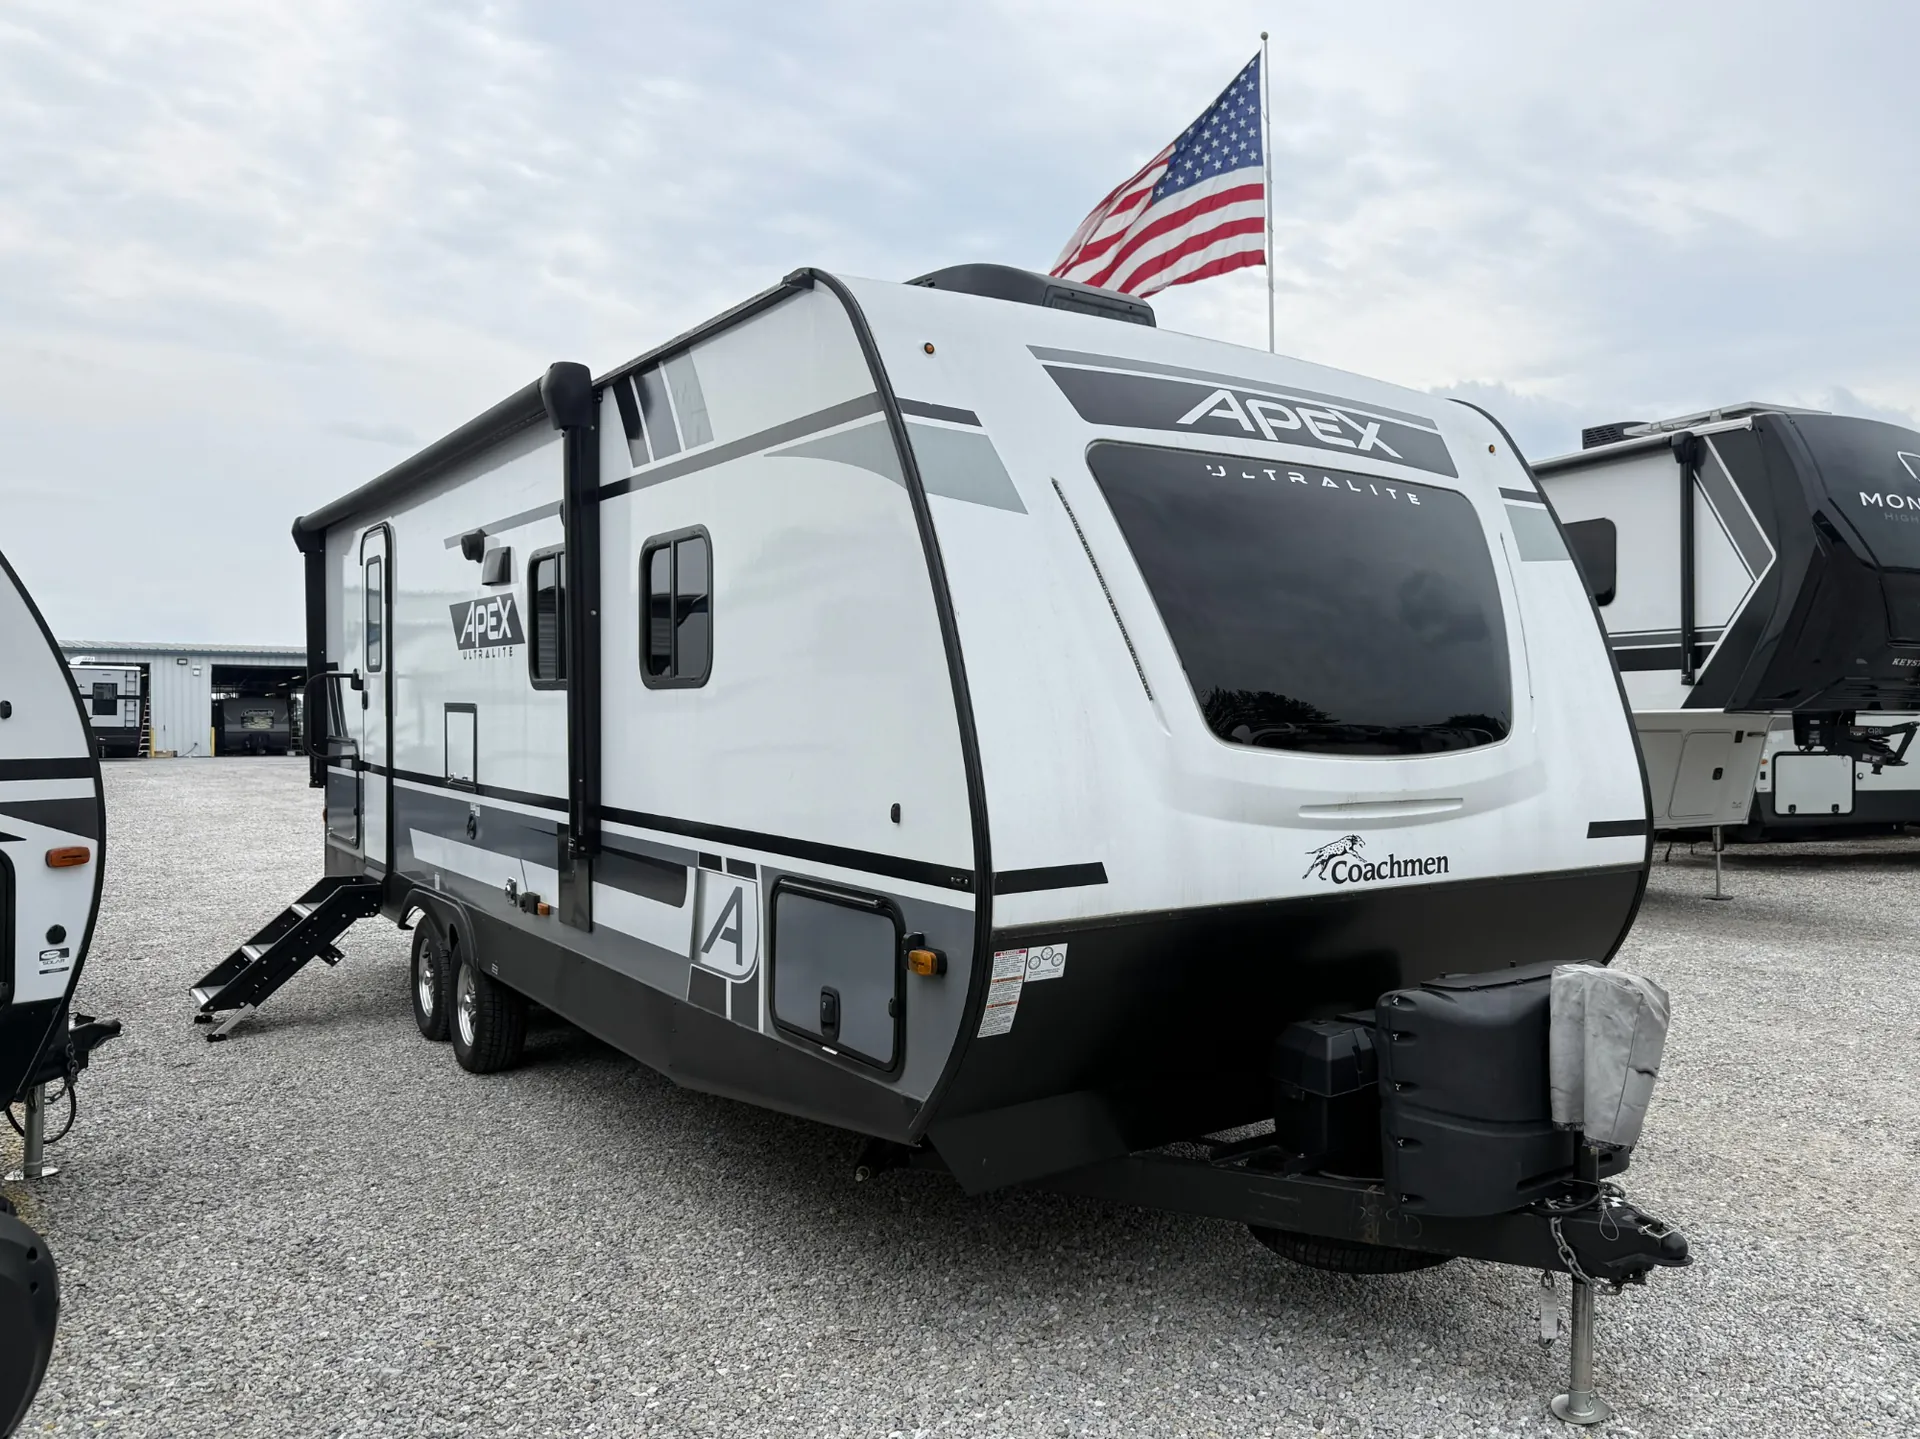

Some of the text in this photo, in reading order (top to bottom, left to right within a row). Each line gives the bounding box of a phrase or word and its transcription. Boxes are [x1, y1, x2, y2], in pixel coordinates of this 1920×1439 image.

[1176, 389, 1404, 459] APEX
[1205, 464, 1421, 506] ULTRALITE
[1859, 491, 1920, 510] MON
[459, 596, 513, 648] APEX
[462, 646, 514, 660] ULTRALITE
[1331, 853, 1449, 884] Coachmen
[701, 886, 742, 966] A
